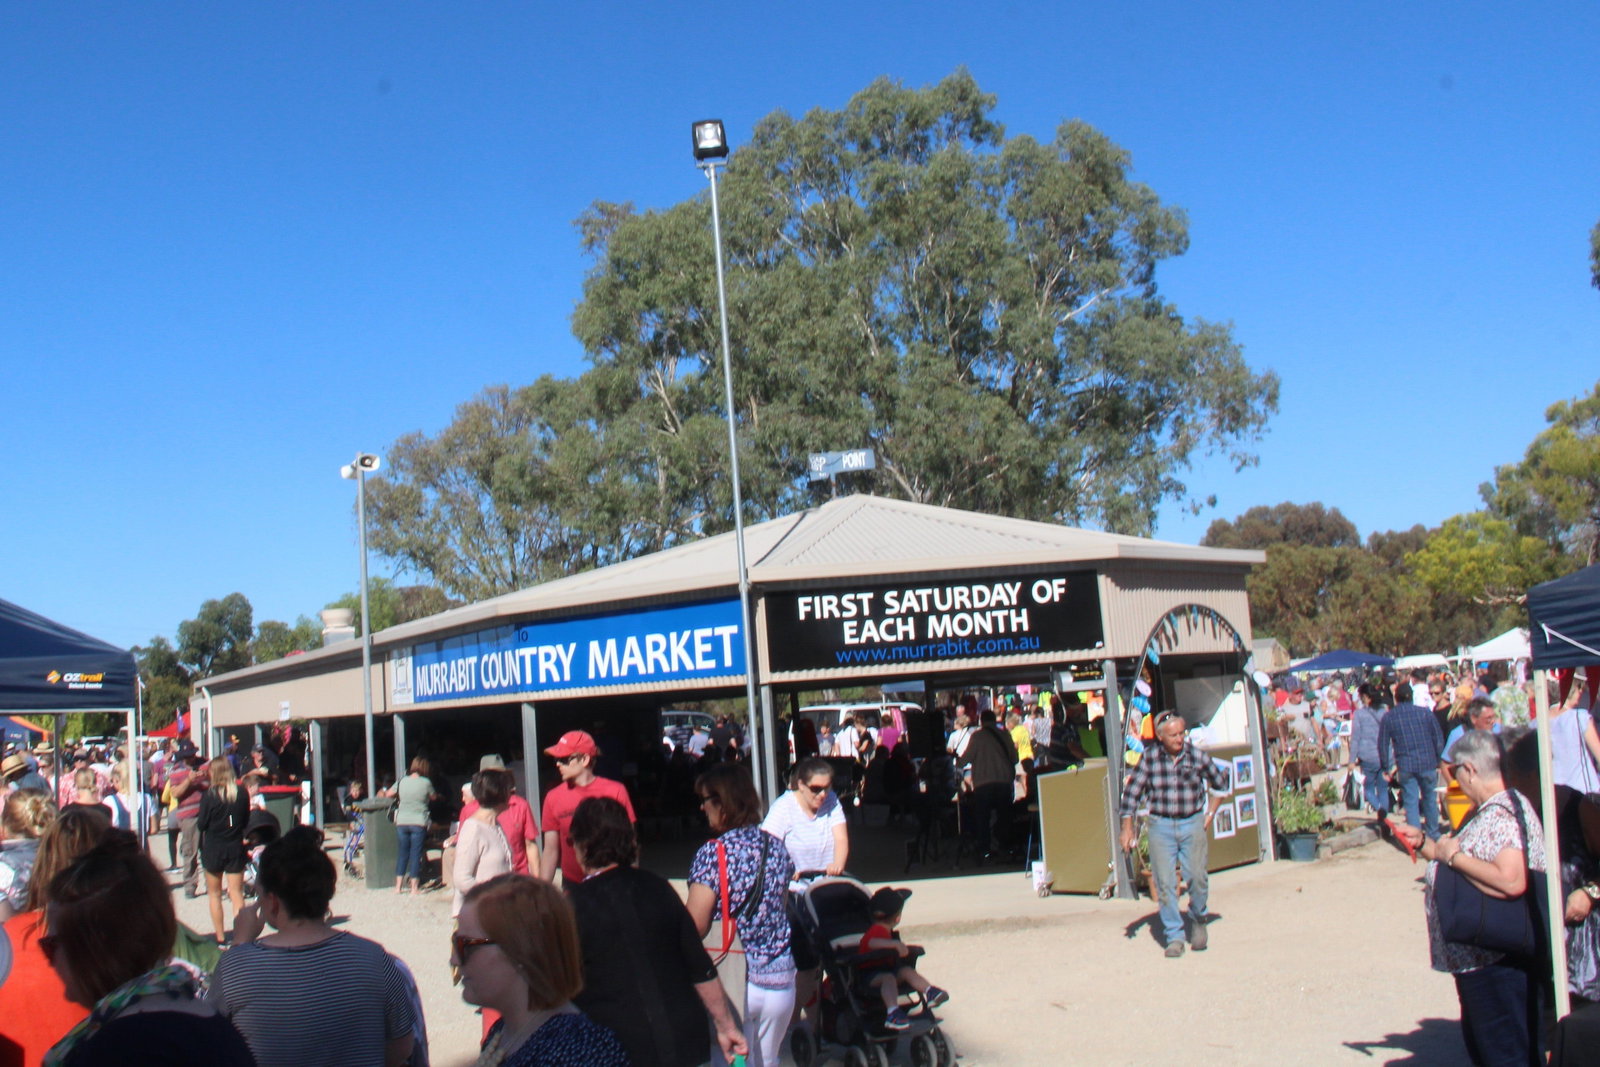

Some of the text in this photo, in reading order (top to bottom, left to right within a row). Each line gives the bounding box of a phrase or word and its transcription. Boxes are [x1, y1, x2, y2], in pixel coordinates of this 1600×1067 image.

[798, 578, 1066, 620] FIRST SATURDAY OF
[843, 608, 1029, 645] EACH MONTH
[416, 624, 738, 697] MURRABIT COUNTRY MARKET
[835, 636, 1040, 663] www.murrabit.com.au
